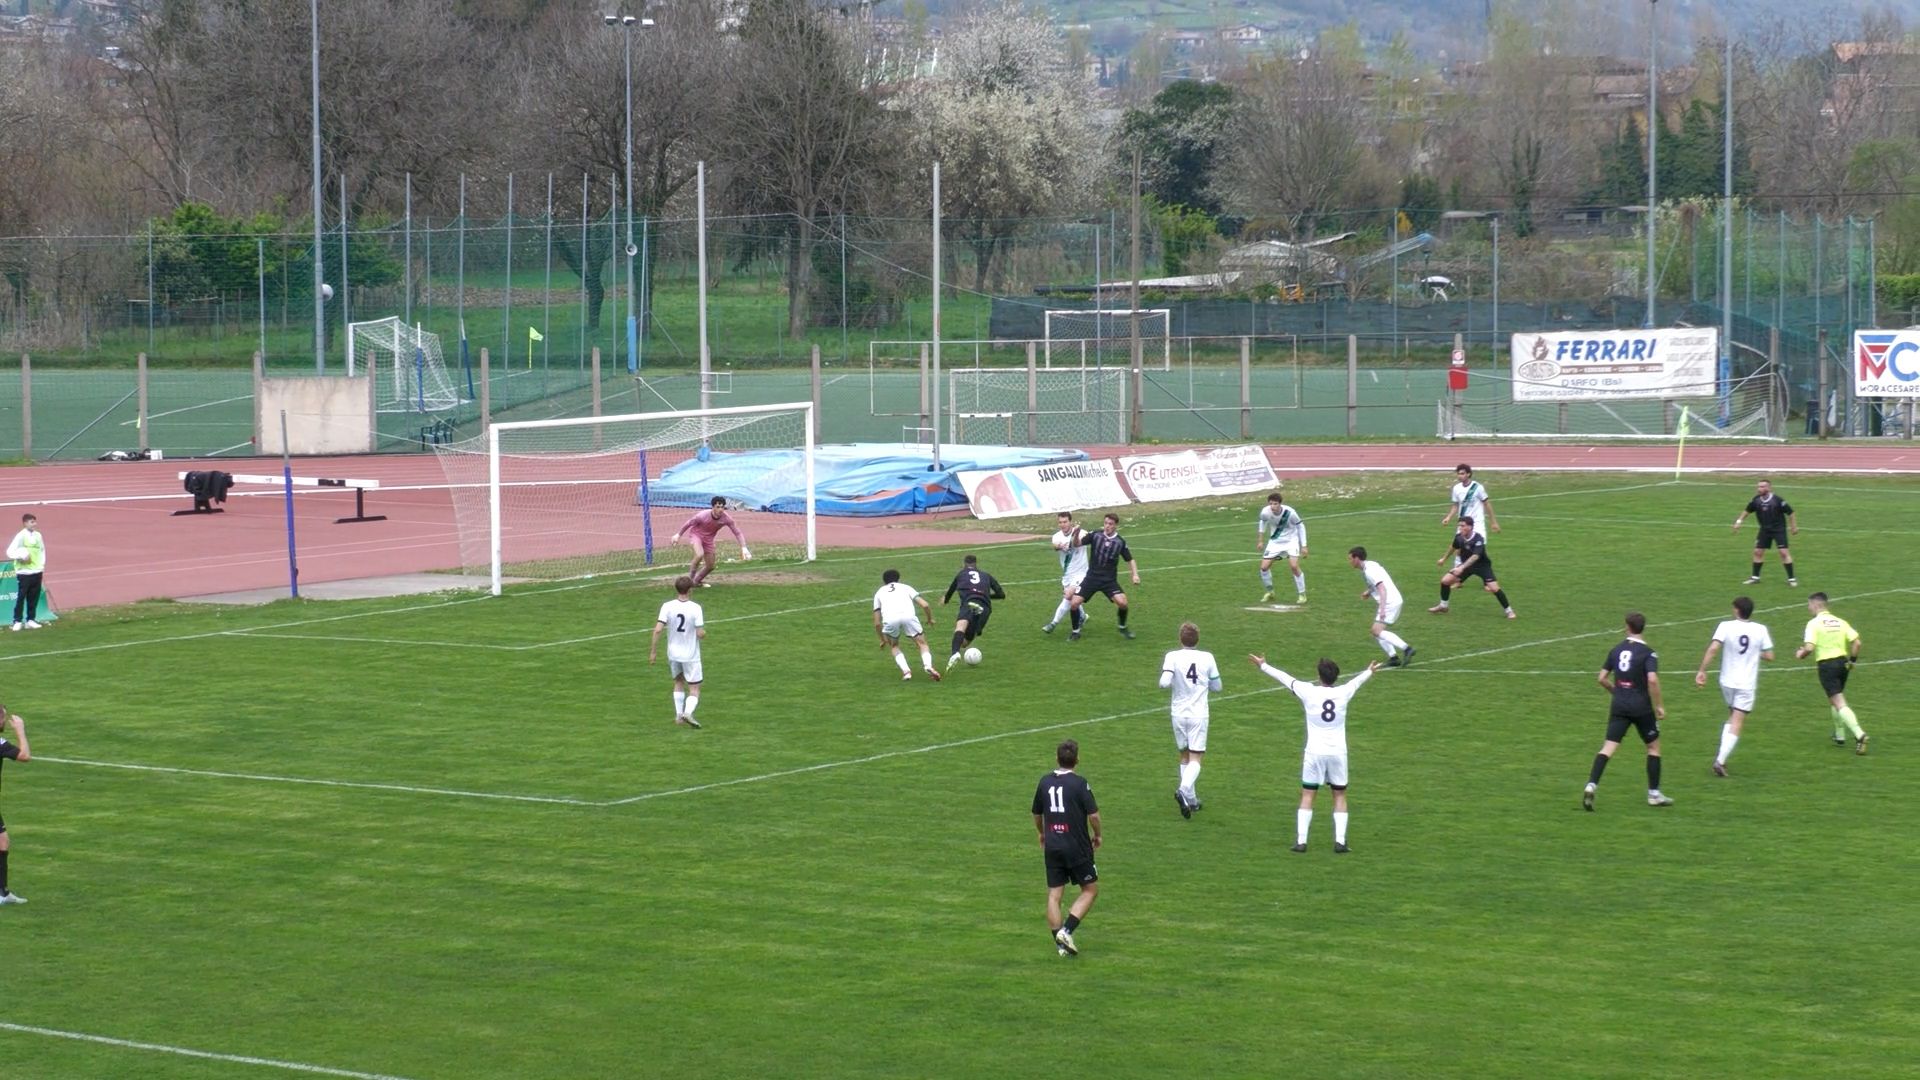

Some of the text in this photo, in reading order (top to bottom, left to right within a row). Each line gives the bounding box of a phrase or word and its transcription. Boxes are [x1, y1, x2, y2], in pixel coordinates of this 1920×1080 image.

[1556, 338, 1657, 362] FERRARI
[968, 571, 981, 584] 3
[677, 614, 685, 632] 2
[1739, 635, 1750, 655] 9
[1619, 650, 1632, 672] 8
[1186, 663, 1198, 684] 4
[1321, 699, 1336, 722] 8
[1048, 786, 1065, 812] 11
